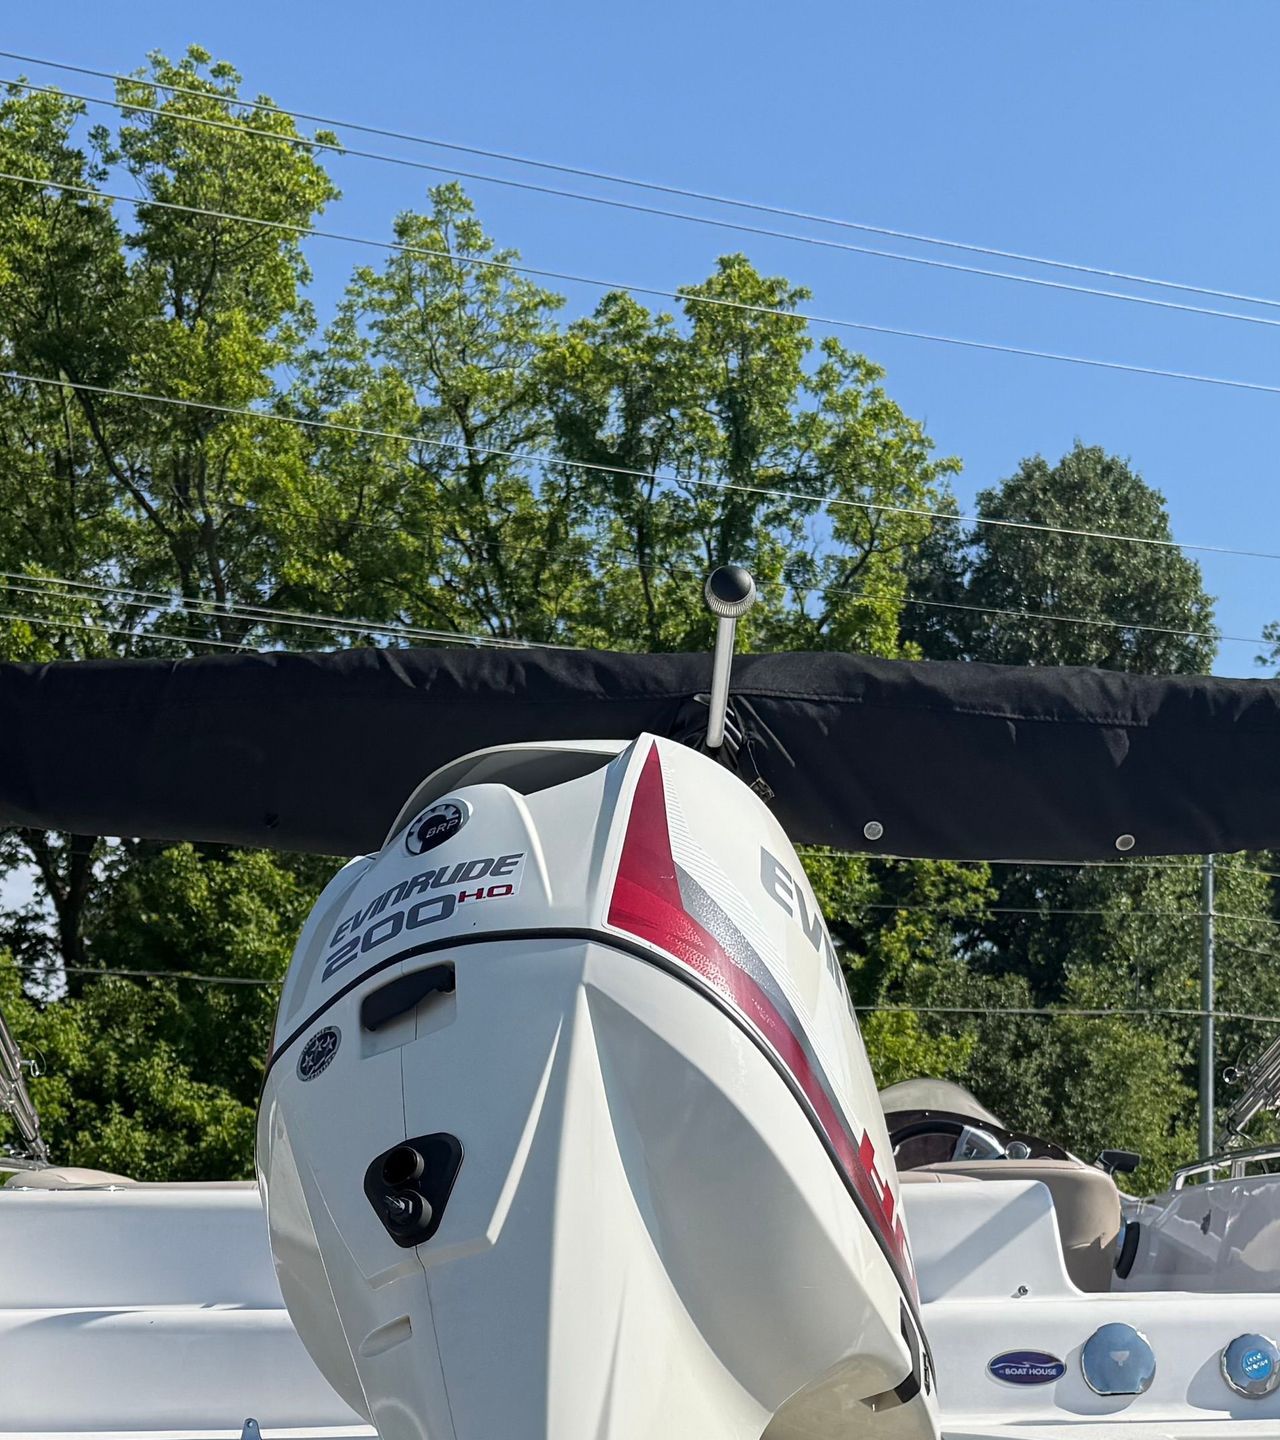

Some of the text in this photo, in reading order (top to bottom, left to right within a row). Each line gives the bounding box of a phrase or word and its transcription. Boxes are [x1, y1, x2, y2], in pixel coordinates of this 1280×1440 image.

[425, 819, 458, 838] BRP
[329, 853, 523, 948] EVINRUDE
[321, 894, 458, 983] 200
[1029, 1368, 1057, 1376] HOUSE
